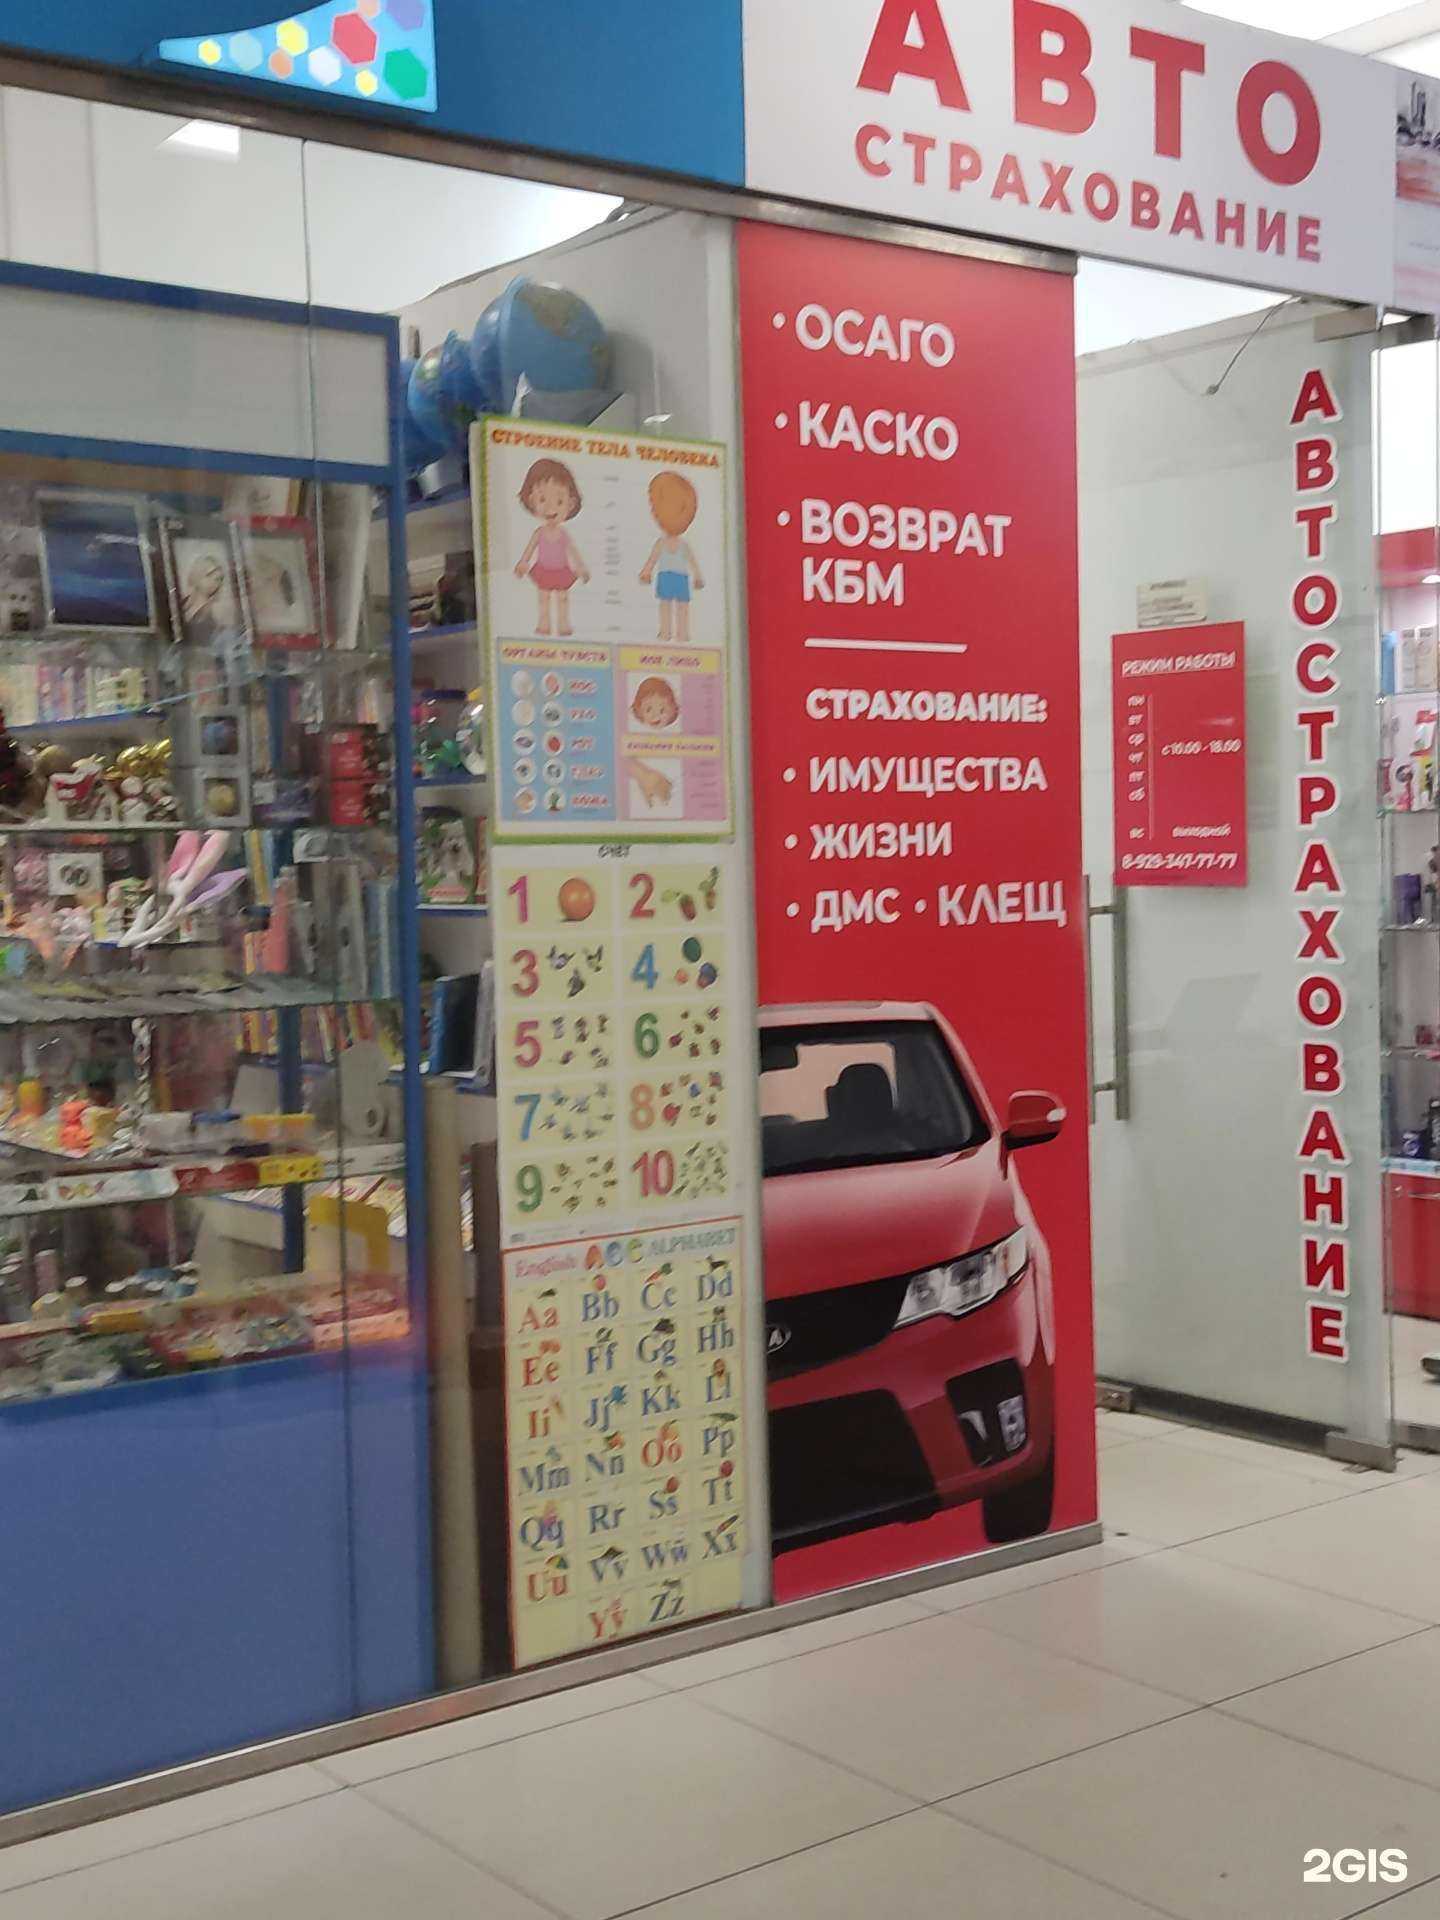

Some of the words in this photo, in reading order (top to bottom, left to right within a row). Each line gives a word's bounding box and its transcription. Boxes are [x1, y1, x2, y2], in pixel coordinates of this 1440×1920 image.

[856, 0, 1321, 187] АВТО
[854, 123, 1321, 263] СТРАХОВАНИЕ
[795, 303, 956, 368] ОСАГО
[491, 428, 582, 453] СТРОЕНИЕ
[587, 439, 630, 459] ТЕЛА
[636, 446, 720, 468] ЧЕЛОВЕКА
[799, 400, 960, 461] КАСКО
[801, 498, 1012, 558] ВОЗВРАТ
[802, 556, 905, 607] КБМ
[1122, 657, 1173, 677] РЕЖИМ
[1175, 651, 1236, 671] РАБОТЫ
[805, 687, 1049, 724] СТРАХОВАНИЕ:
[809, 756, 1049, 799] ИМУЩЕСТВА
[809, 821, 953, 861] ЖИЗНИ
[1290, 368, 1347, 1358] АВТОСТРАХОВАНИЕ
[508, 875, 529, 923] 1
[629, 872, 656, 920] 2
[810, 887, 901, 934] ДМС
[938, 880, 1068, 928] КЛЕЩ
[512, 948, 539, 998] 3
[631, 943, 659, 990] 4
[513, 1020, 542, 1068] 5
[633, 1012, 660, 1059] 6
[514, 1092, 541, 1142] 7
[629, 1083, 655, 1131] 8
[516, 1164, 543, 1214] 9
[631, 1149, 675, 1198] 10
[518, 1304, 559, 1334] Aa
[581, 1290, 620, 1322] Bb
[641, 1282, 678, 1311] Cc
[697, 1270, 734, 1302] Dd
[521, 1356, 560, 1387] Ee
[586, 1341, 618, 1375] Ff
[636, 1334, 678, 1367] Gg
[697, 1320, 735, 1353] Hh
[641, 1384, 681, 1416] Kk
[705, 1371, 732, 1403] Ll
[518, 1462, 570, 1496] Mm
[584, 1451, 625, 1481] Nn
[641, 1438, 682, 1468] Oo
[702, 1426, 735, 1457] Pp
[520, 1515, 565, 1552] Qq
[588, 1504, 626, 1535] Rr
[648, 1490, 679, 1520] Ss
[703, 1476, 734, 1505] Tt
[527, 1572, 568, 1602] Uu
[589, 1555, 629, 1582] Vv
[641, 1543, 688, 1571] Ww
[702, 1530, 738, 1560] Xx
[649, 1589, 685, 1622] Zz
